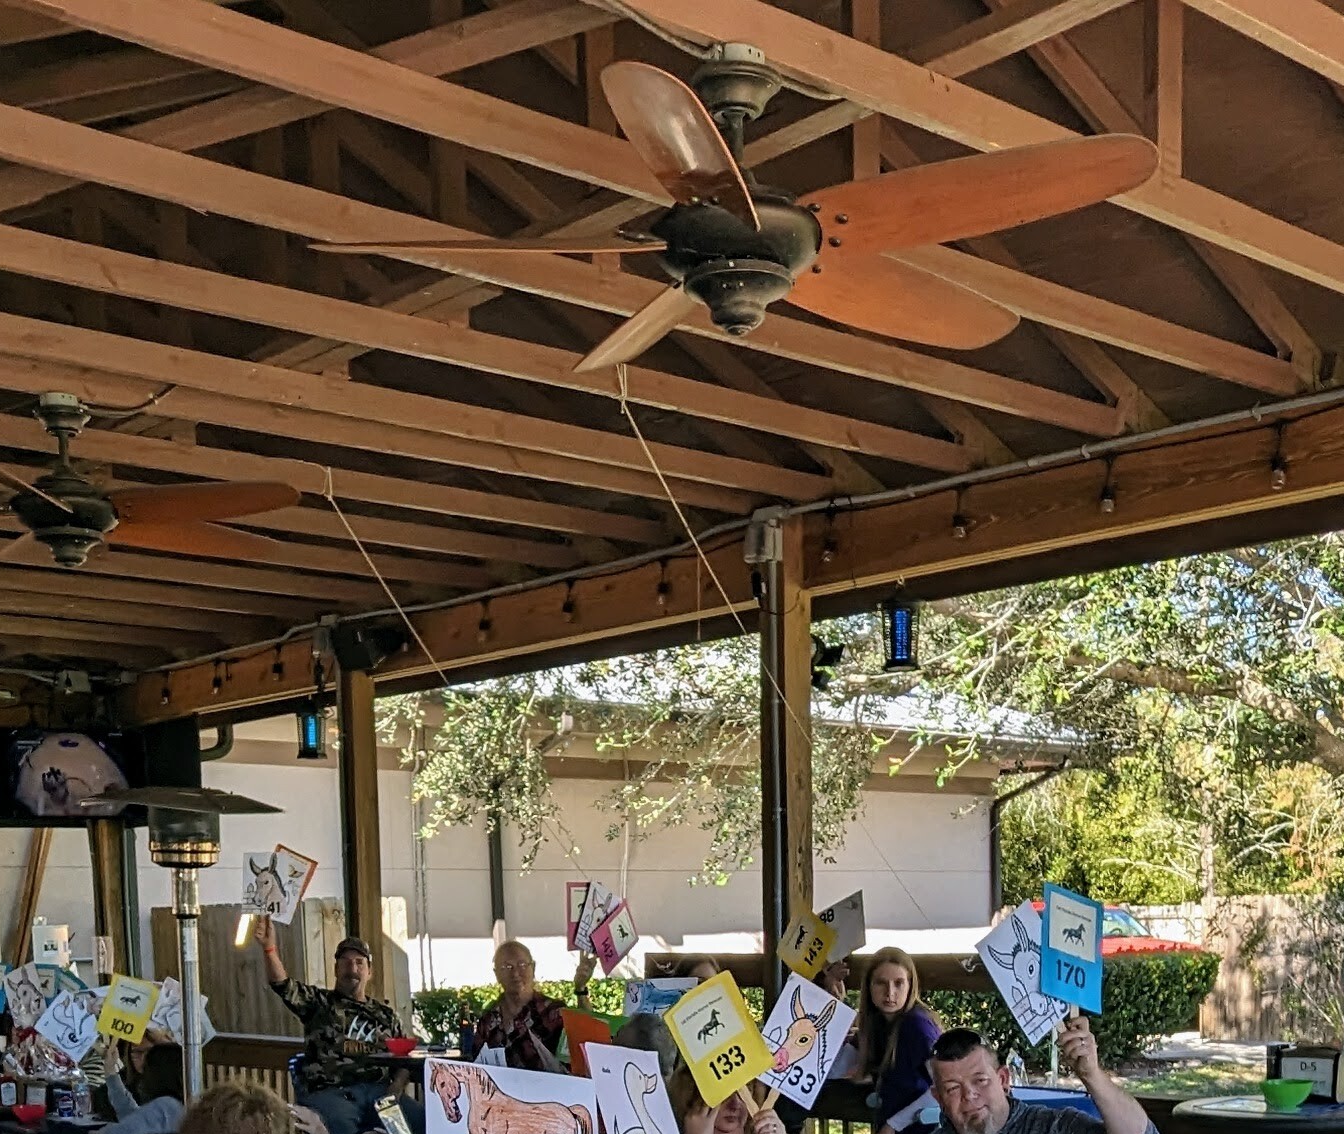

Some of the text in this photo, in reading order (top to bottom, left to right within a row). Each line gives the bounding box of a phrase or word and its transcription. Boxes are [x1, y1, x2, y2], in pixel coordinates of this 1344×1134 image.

[266, 901, 281, 914] 41
[804, 937, 824, 967] 143
[1056, 958, 1086, 989] 170
[110, 1017, 134, 1036] 100
[709, 1045, 746, 1081] 133
[787, 1065, 817, 1094] 33
